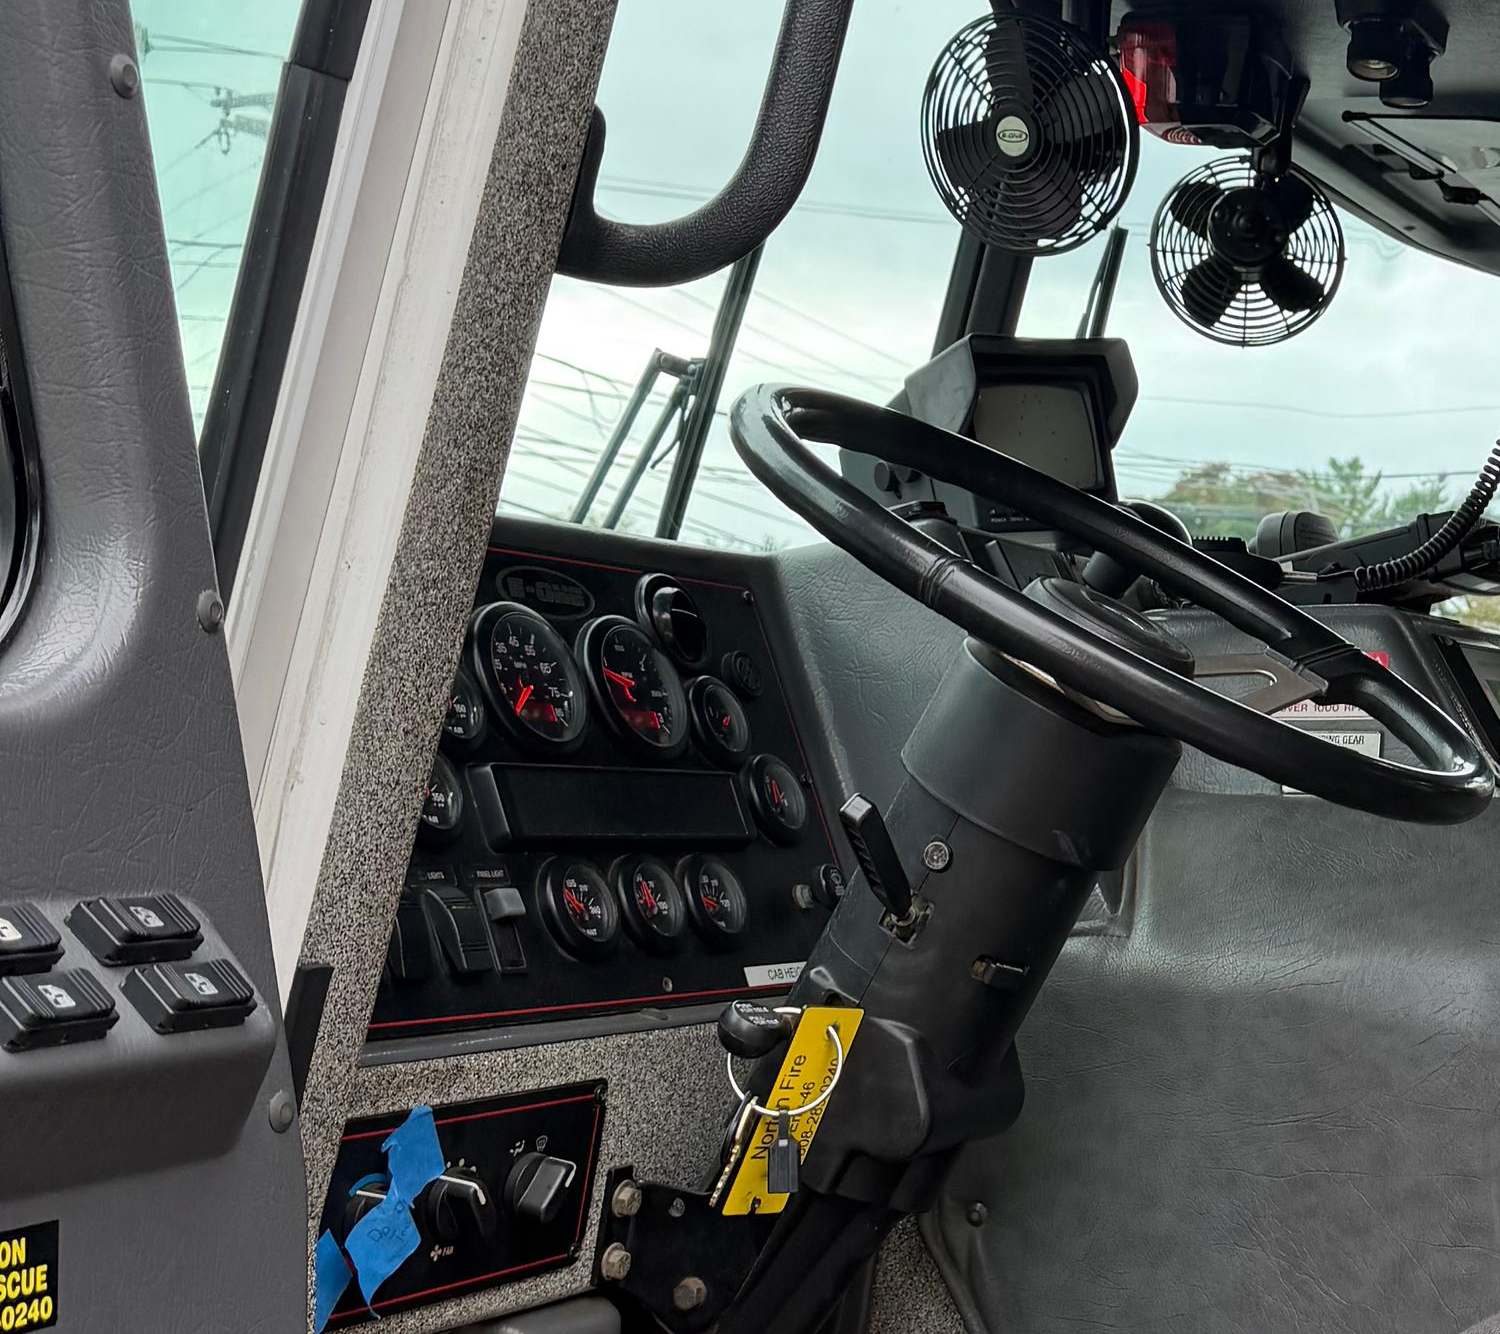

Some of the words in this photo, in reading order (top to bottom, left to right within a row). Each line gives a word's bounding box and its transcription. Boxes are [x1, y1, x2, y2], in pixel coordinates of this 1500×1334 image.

[540, 662, 552, 675] 65
[548, 686, 561, 698] 75
[1342, 735, 1365, 746] GEAR
[767, 968, 784, 980] CAB
[751, 1094, 782, 1160] Nortn
[779, 1054, 808, 1091] Fire
[0, 1237, 26, 1269] ON
